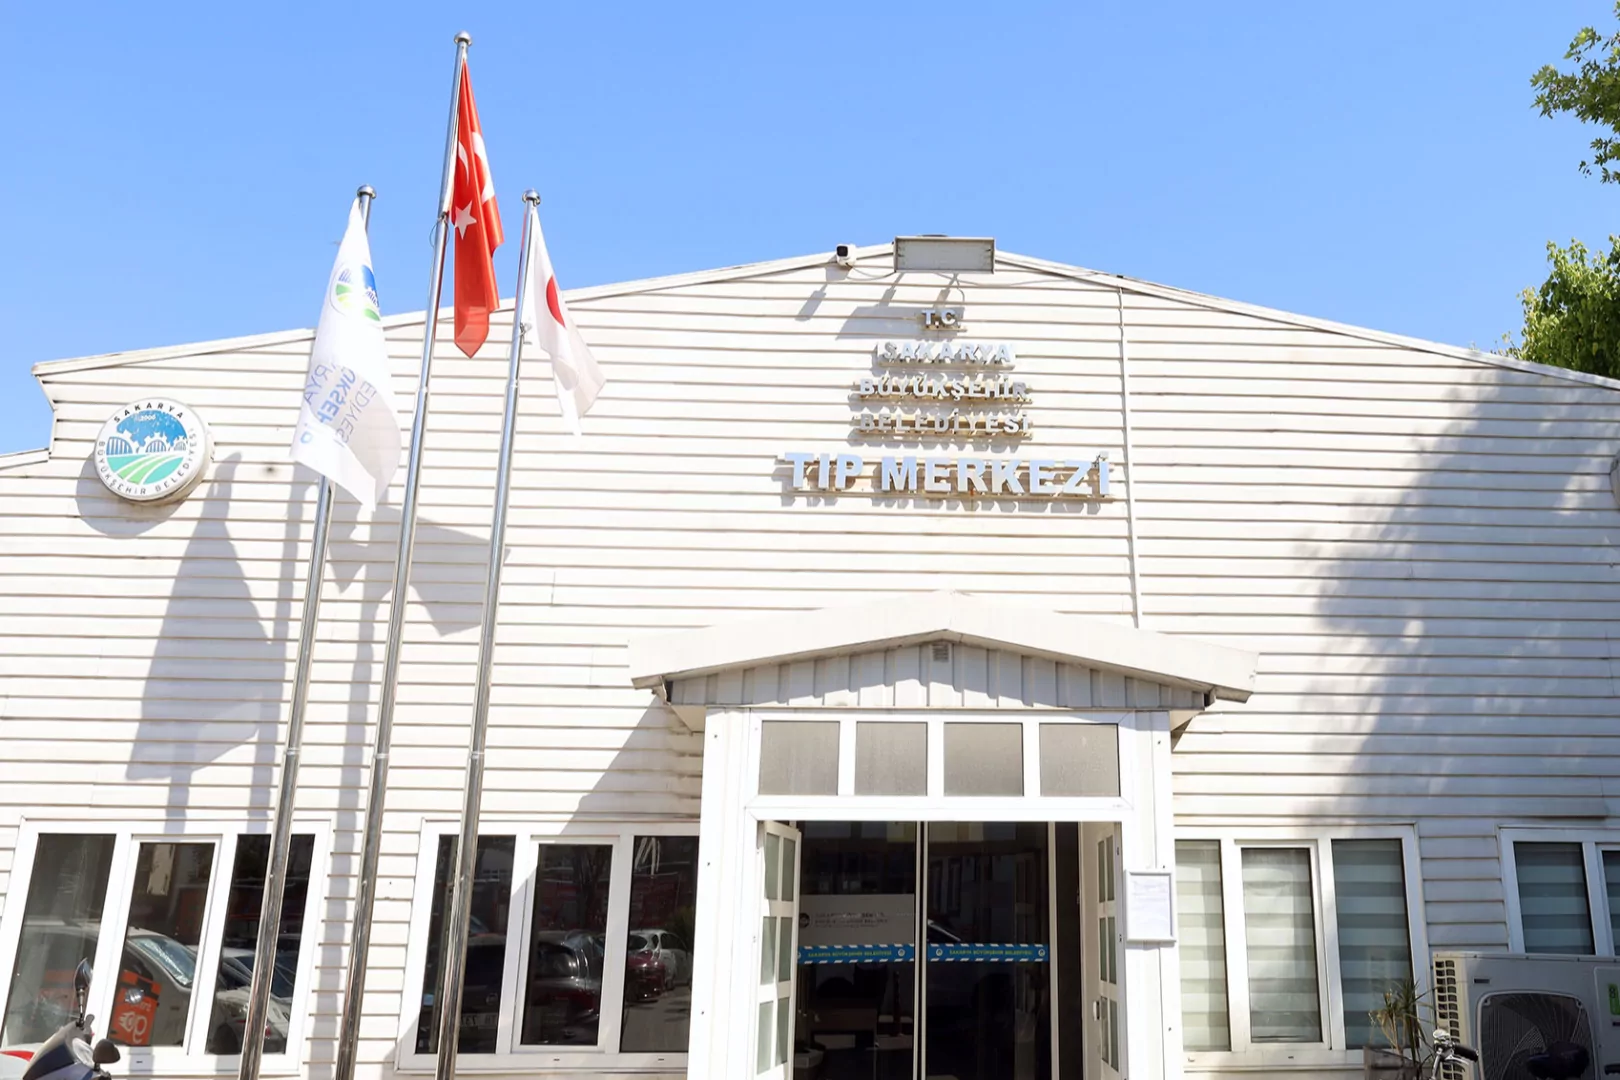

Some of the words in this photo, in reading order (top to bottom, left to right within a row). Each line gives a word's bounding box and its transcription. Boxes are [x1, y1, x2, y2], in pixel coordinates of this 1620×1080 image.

[883, 341, 1012, 361] SAKARYA
[860, 375, 1028, 401] BÜYÜKŞEHİR
[113, 402, 185, 423] SAKARYA
[860, 407, 1029, 433] BELEDİYESİ
[785, 452, 863, 489] TIP
[881, 451, 1110, 495] MERKEZİ
